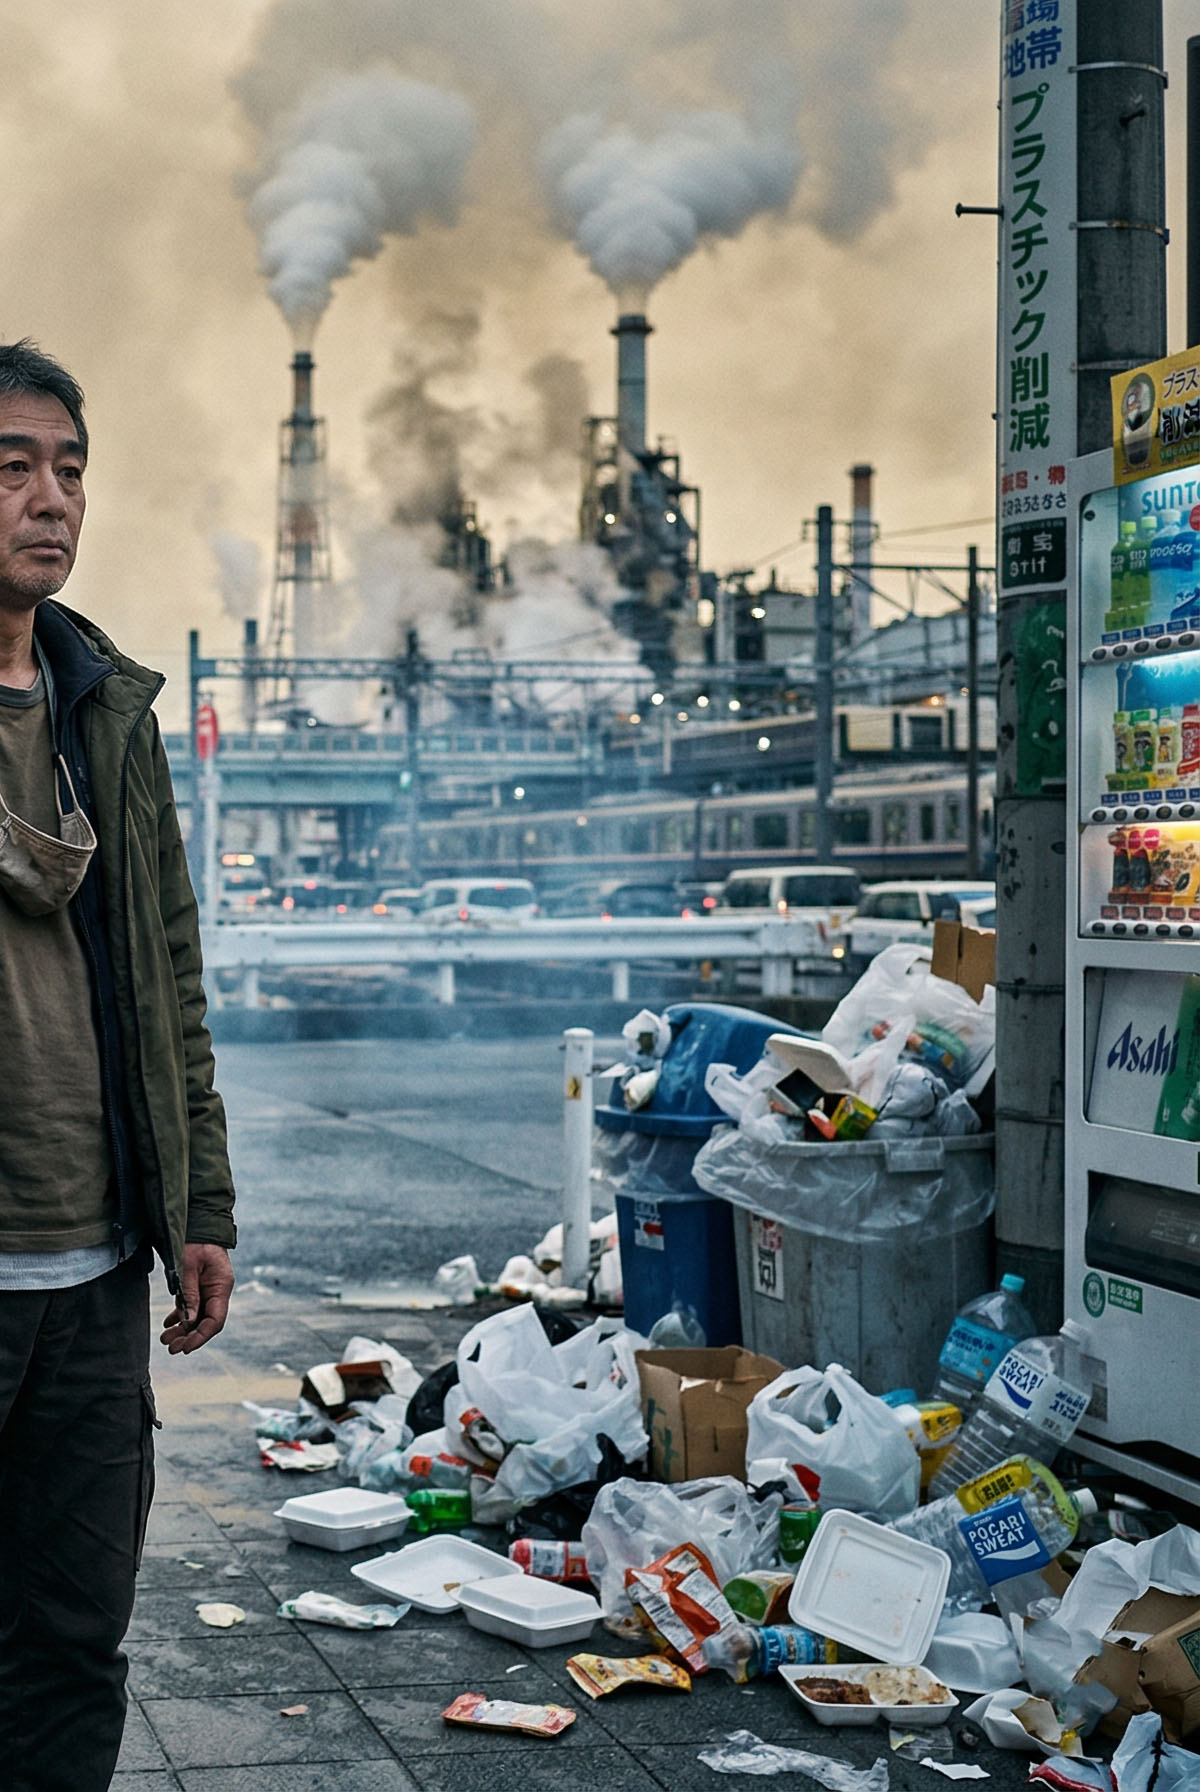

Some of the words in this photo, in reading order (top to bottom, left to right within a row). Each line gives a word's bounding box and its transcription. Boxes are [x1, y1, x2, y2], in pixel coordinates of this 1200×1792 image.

[1009, 82, 1050, 453] プラスチック削減
[1107, 1021, 1181, 1077] Asahi
[968, 1511, 1026, 1543] POCARI
[974, 1526, 1026, 1557] SWEAT
